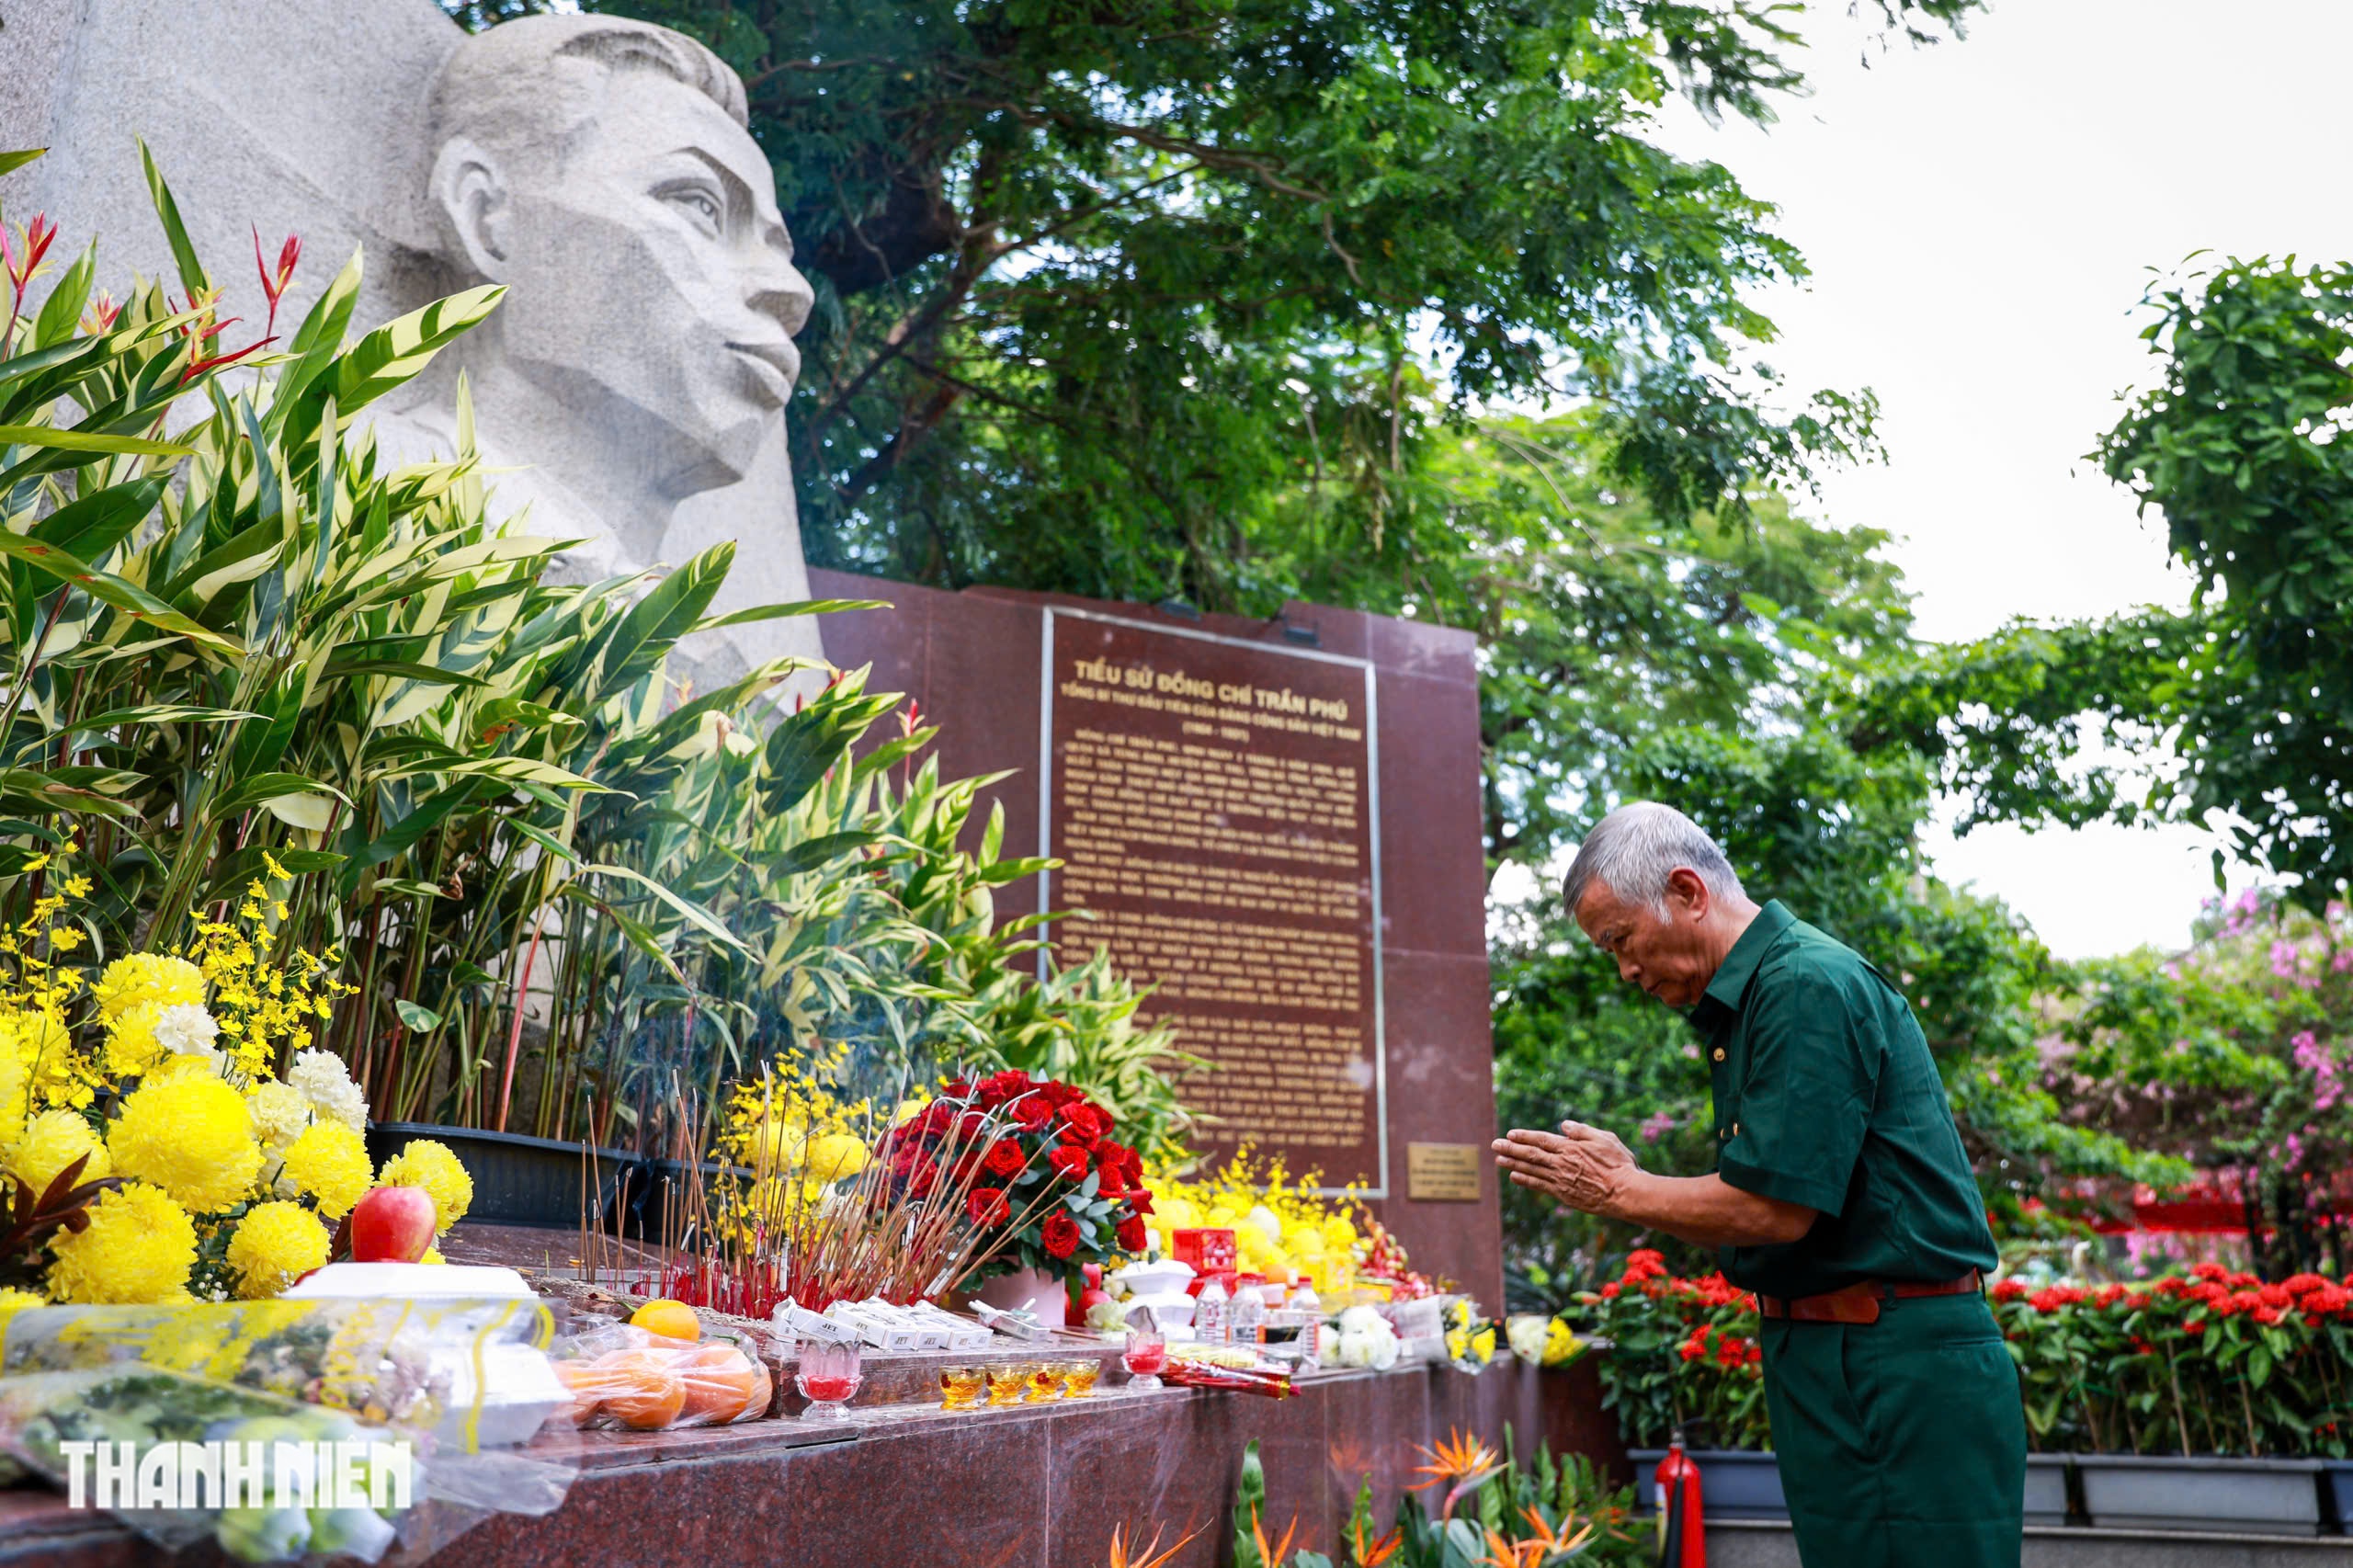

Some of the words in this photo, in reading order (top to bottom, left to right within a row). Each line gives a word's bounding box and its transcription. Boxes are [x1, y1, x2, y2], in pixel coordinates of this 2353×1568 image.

[1218, 683, 1252, 705] CHÍ
[1254, 687, 1306, 715] TRẦN
[1309, 698, 1348, 722] PHÚ
[822, 1323, 838, 1332] JET
[856, 1322, 869, 1331] JET
[895, 1336, 908, 1345] JET
